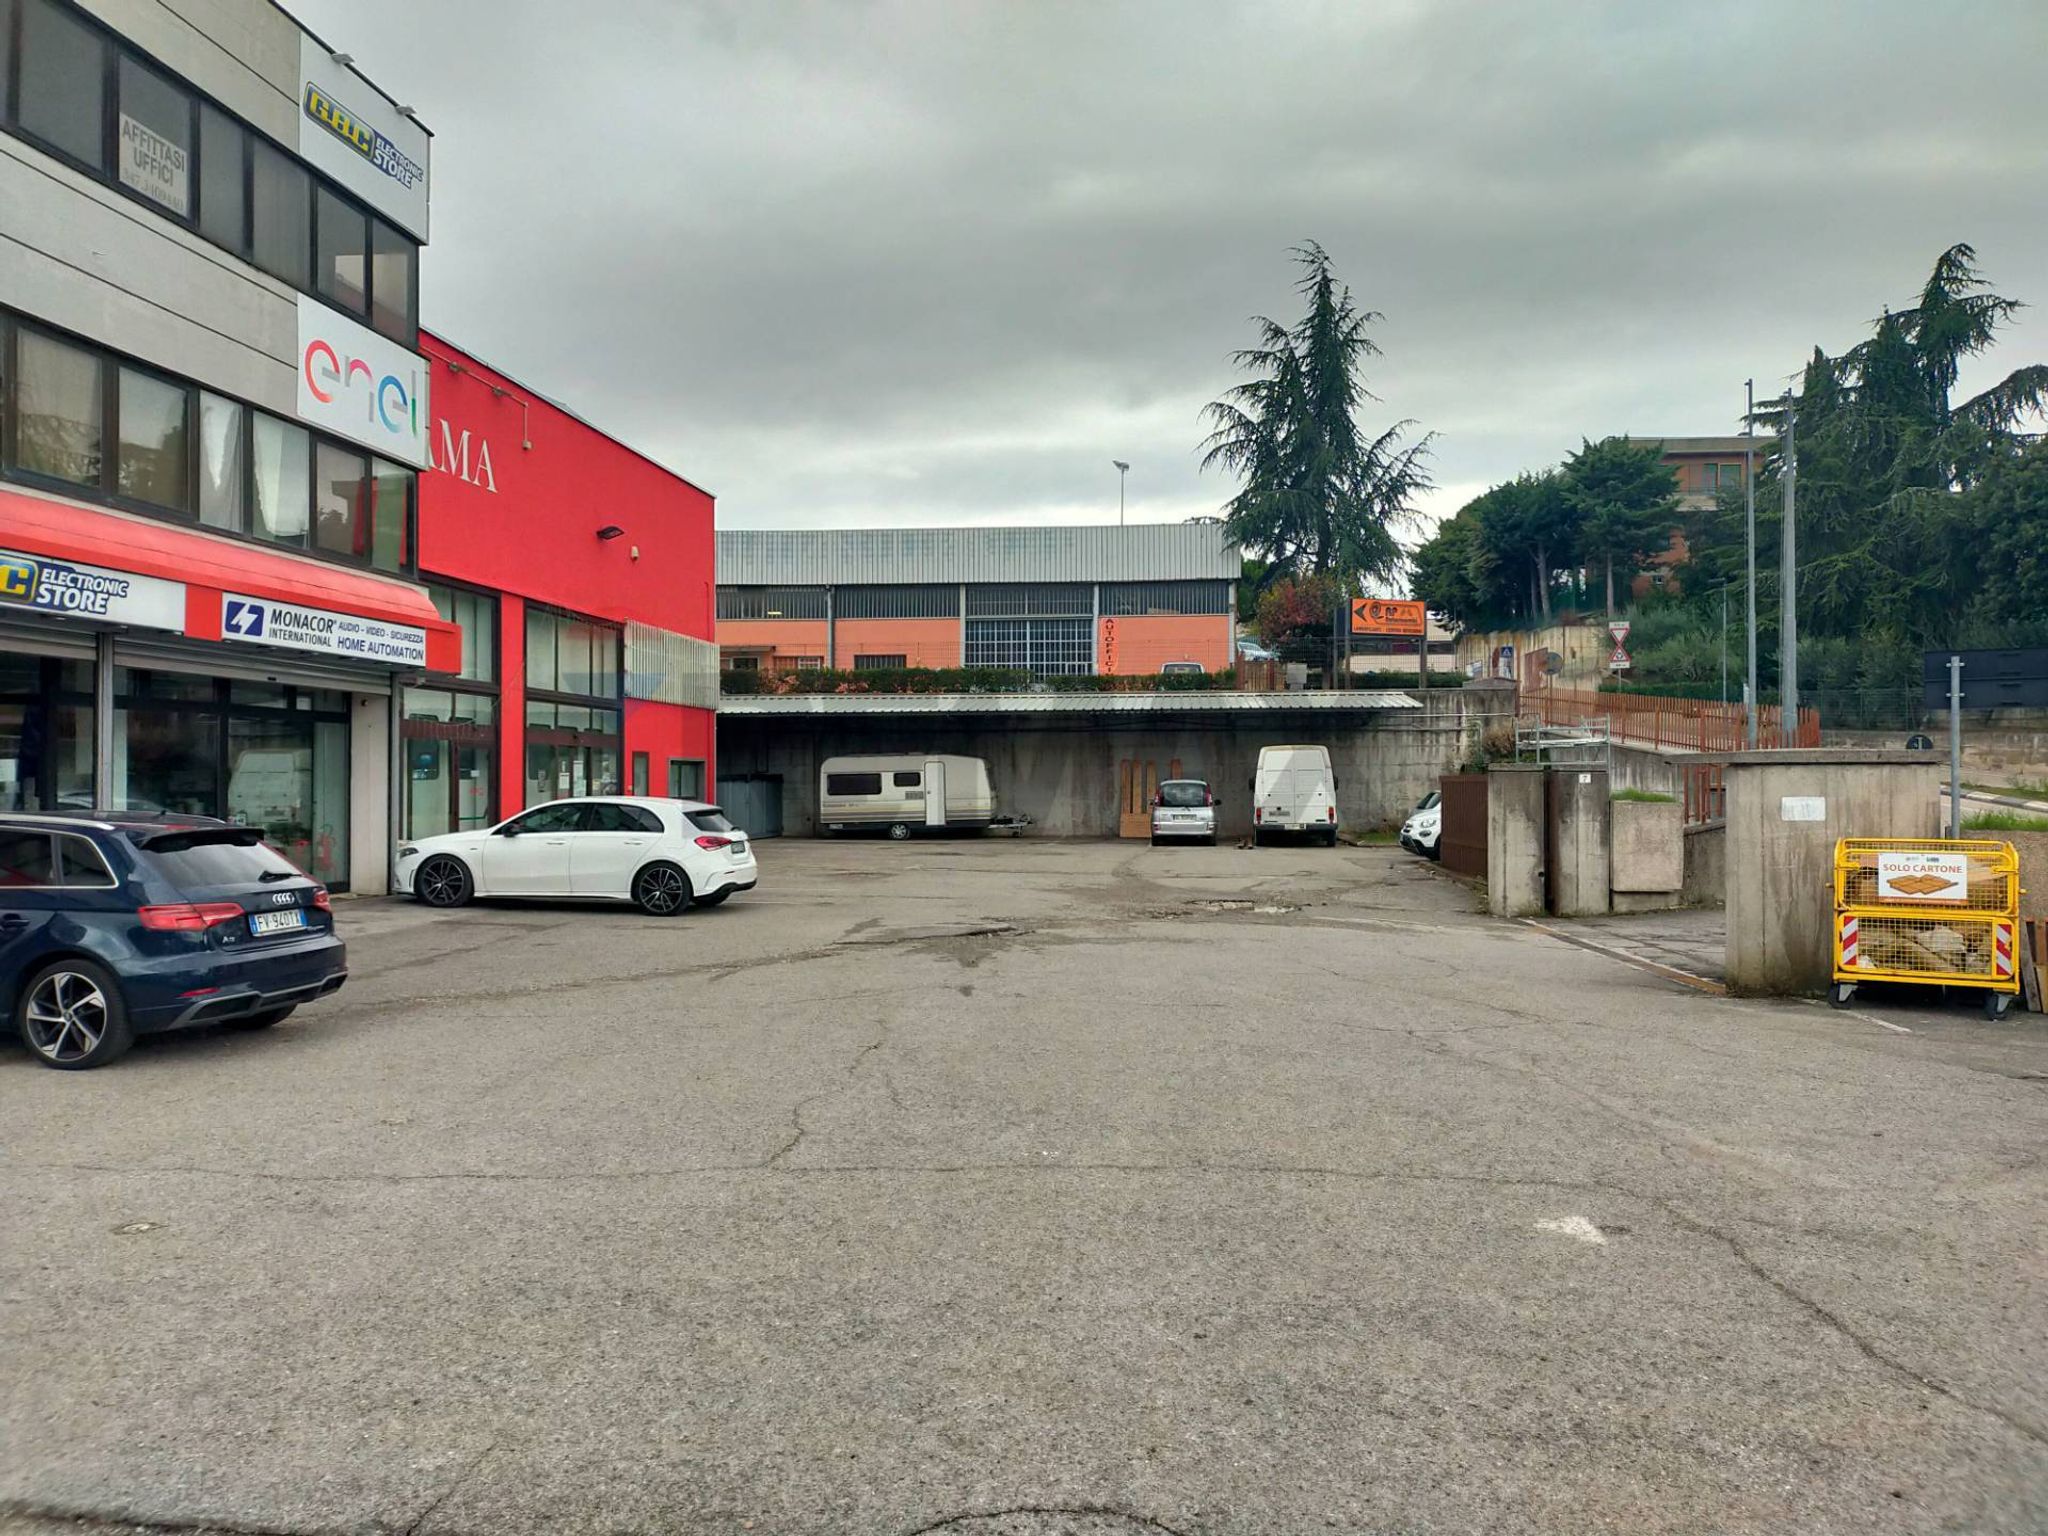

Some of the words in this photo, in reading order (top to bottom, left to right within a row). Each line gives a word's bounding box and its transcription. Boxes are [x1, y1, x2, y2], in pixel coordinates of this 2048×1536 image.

[122, 119, 185, 172] AFFITTASI
[375, 138, 423, 181] ELECTRONIC
[133, 146, 174, 187] UFFICI
[374, 150, 413, 189] STORE
[304, 340, 418, 437] enel
[36, 584, 108, 613] STORE
[40, 568, 129, 597] ELECTRONIC
[269, 628, 332, 647] INTERNATIONAL
[337, 636, 366, 652] HOME
[367, 641, 424, 661] AUTOMATION
[338, 622, 360, 633] AUDIO
[365, 626, 385, 637] VIDEO
[390, 631, 424, 644] SICUREZZA
[1105, 618, 1115, 676] AUTOFFICI
[1883, 863, 1911, 872] SOLO
[1913, 864, 1963, 874] CARTONE
